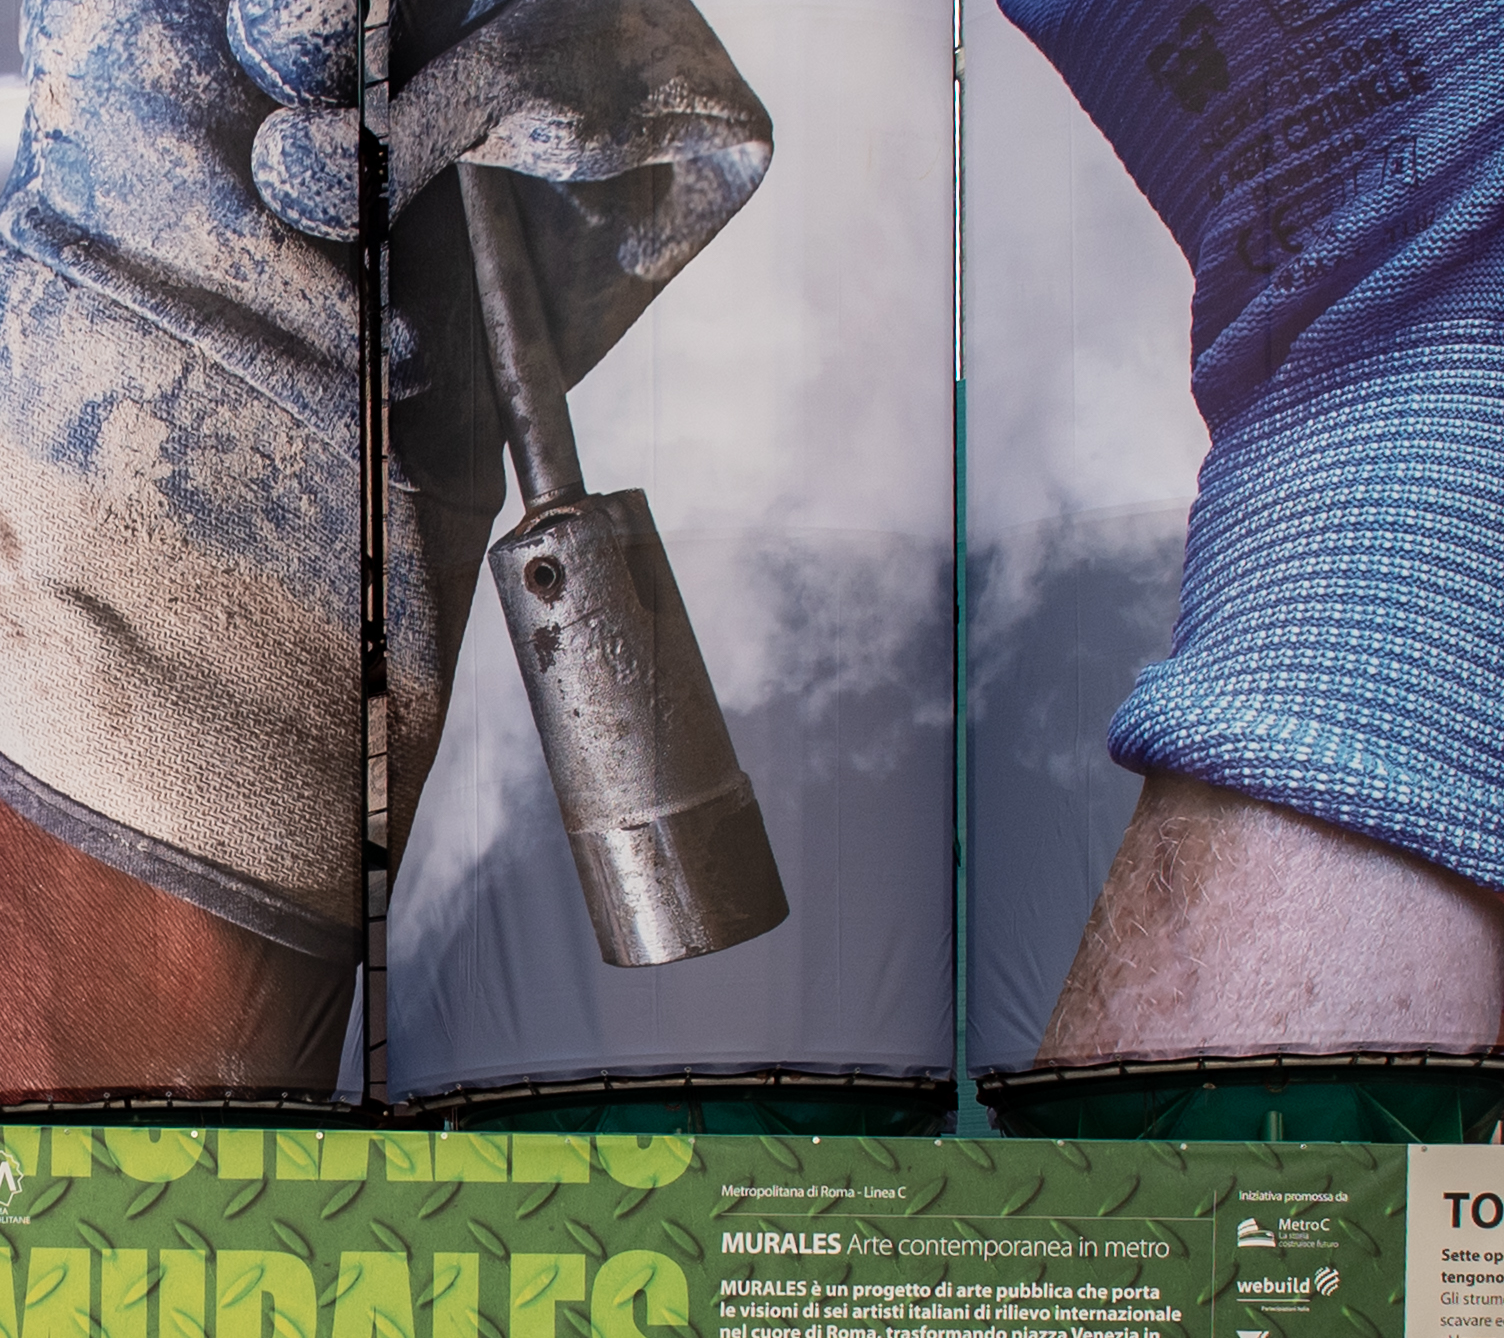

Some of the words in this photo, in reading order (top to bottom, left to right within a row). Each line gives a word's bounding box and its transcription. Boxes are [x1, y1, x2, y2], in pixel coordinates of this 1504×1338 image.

[721, 1184, 804, 1200] Metropolitana
[806, 1185, 818, 1197] di
[820, 1185, 855, 1198] Roma
[864, 1186, 895, 1199] Linea
[897, 1186, 906, 1199] C
[1239, 1190, 1282, 1201] Iniziativa
[1284, 1193, 1333, 1203] promossa
[1334, 1192, 1348, 1202] da
[721, 1231, 842, 1254] MURALES
[846, 1233, 892, 1255] Arte
[898, 1236, 1072, 1262] contemporanea
[1079, 1236, 1097, 1257] in
[1104, 1238, 1169, 1258] metro
[1441, 1248, 1480, 1262] Sette
[1237, 1276, 1310, 1293] webuild
[1441, 1271, 1504, 1287] tengono
[719, 1279, 807, 1296] MURALES
[811, 1280, 822, 1296] è
[826, 1284, 848, 1297] un
[852, 1282, 931, 1302] progetto
[934, 1281, 952, 1298] di
[956, 1283, 992, 1298] arte
[996, 1281, 1073, 1303] pubblica
[1076, 1282, 1108, 1299] che
[1111, 1285, 1160, 1303] porta
[719, 1301, 736, 1318] le
[739, 1301, 798, 1318] visioni
[802, 1301, 819, 1318] di
[823, 1302, 848, 1319] sei
[852, 1302, 904, 1319] artisti
[908, 1302, 970, 1320] italiani
[974, 1303, 991, 1320] di
[995, 1303, 1051, 1320] rilievo
[1054, 1304, 1182, 1322] internazionale
